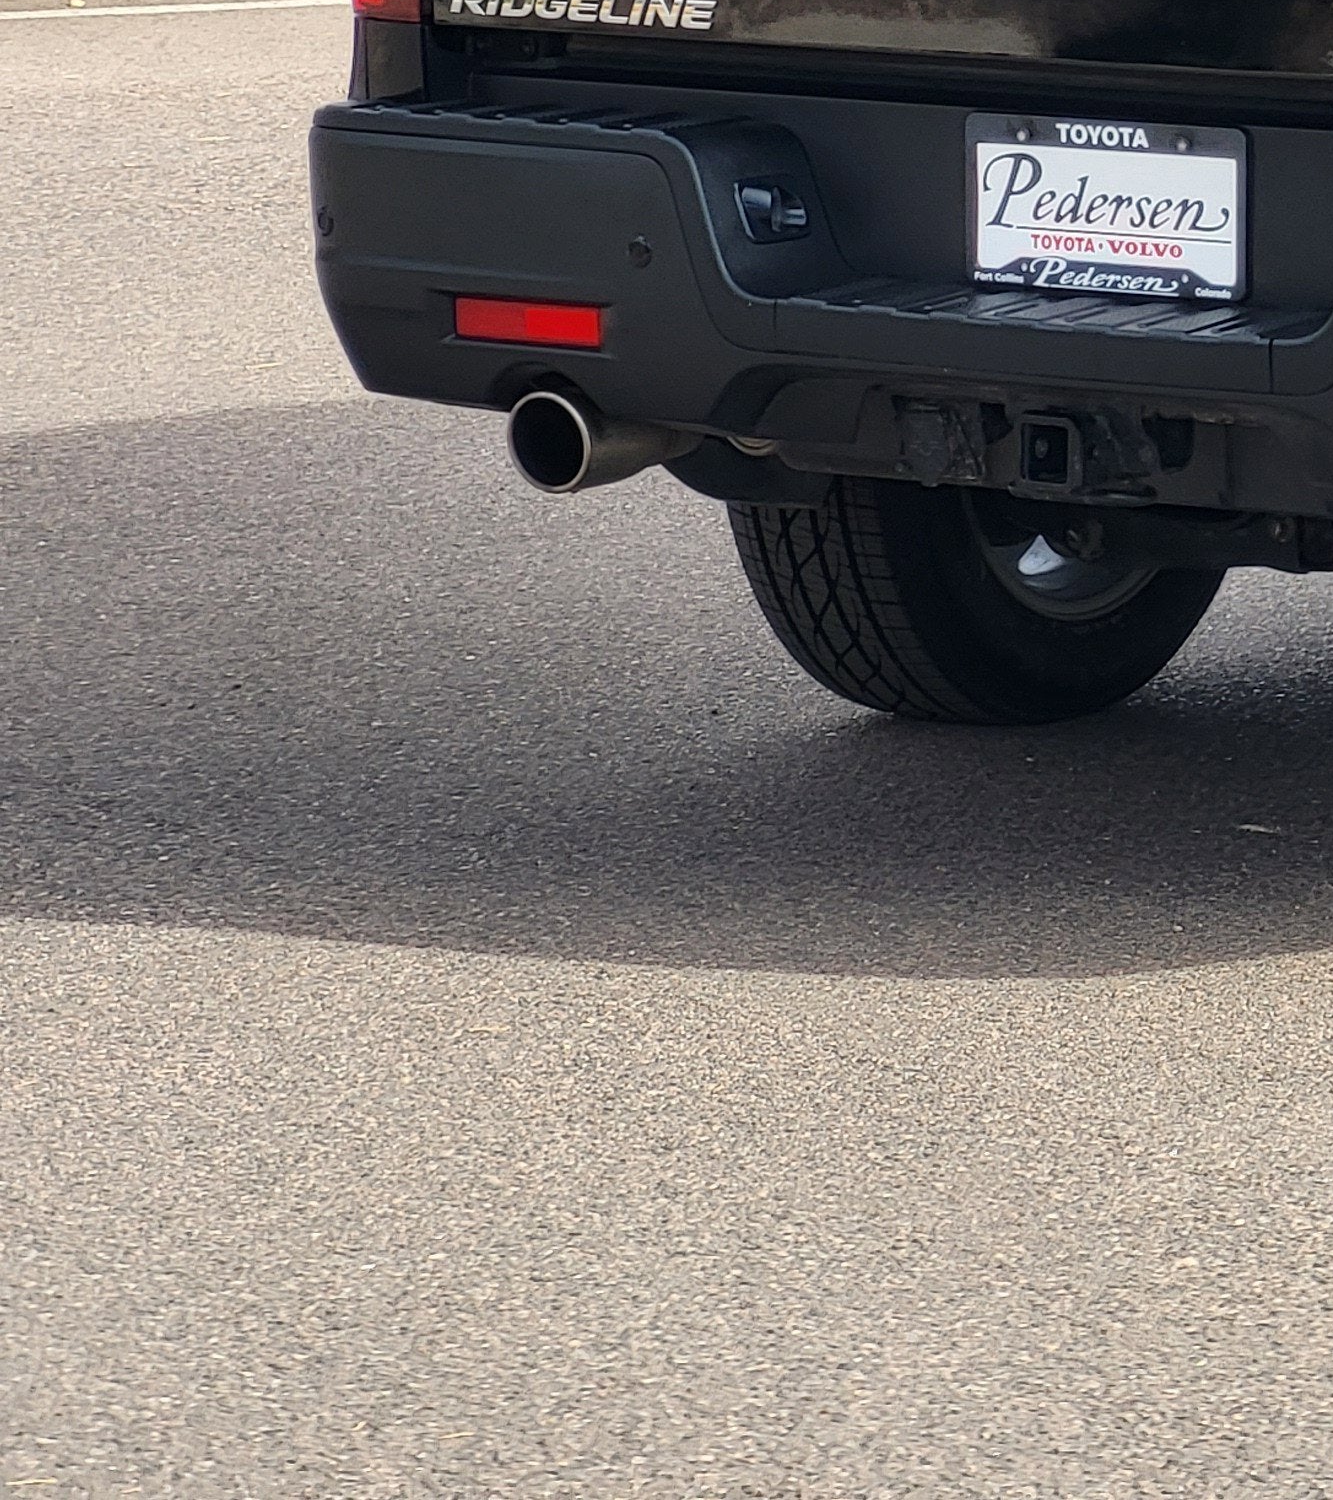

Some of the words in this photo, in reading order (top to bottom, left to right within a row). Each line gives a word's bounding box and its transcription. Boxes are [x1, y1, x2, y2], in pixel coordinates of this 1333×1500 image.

[1055, 123, 1149, 148] TOYOTA
[983, 152, 1230, 233] Pedersen
[1031, 234, 1096, 253] TOYOTA
[1106, 239, 1183, 258] VOLVO
[1030, 256, 1179, 293] Pedersen
